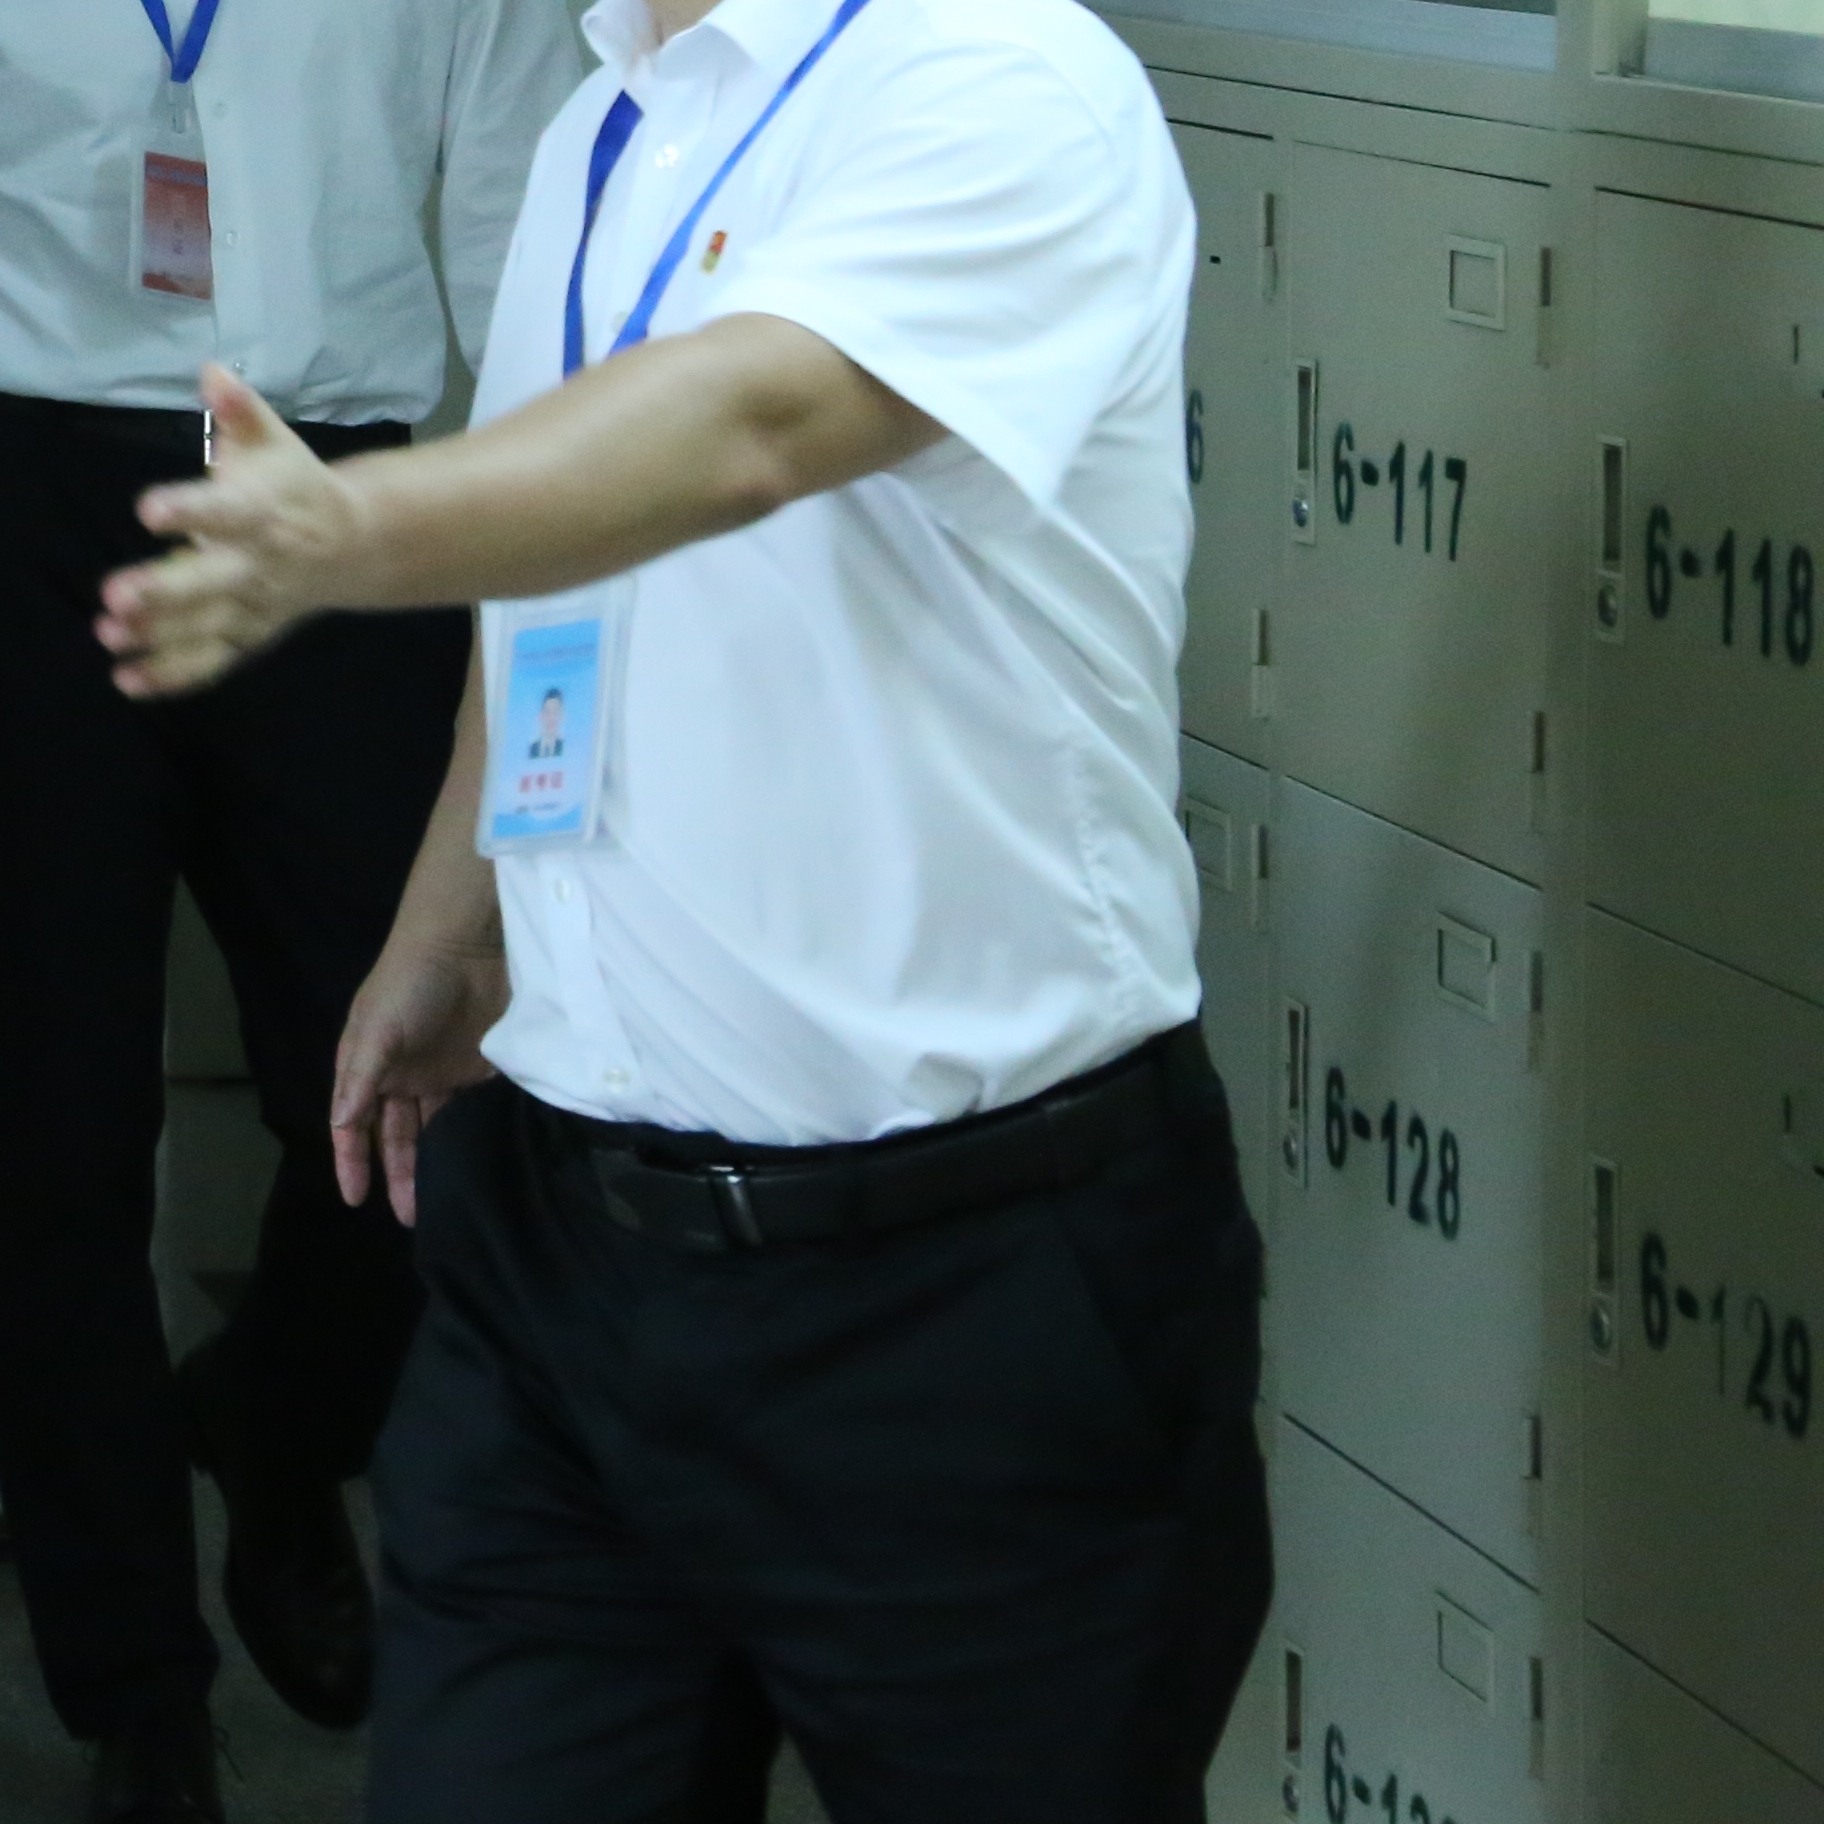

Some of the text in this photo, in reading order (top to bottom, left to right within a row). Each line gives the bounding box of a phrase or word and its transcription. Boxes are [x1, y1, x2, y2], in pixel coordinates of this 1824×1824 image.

[1333, 422, 1468, 563] 6-117
[1646, 504, 1816, 667] 6-118
[1325, 1066, 1461, 1241] 6-128
[1640, 1232, 1813, 1441] 6-129
